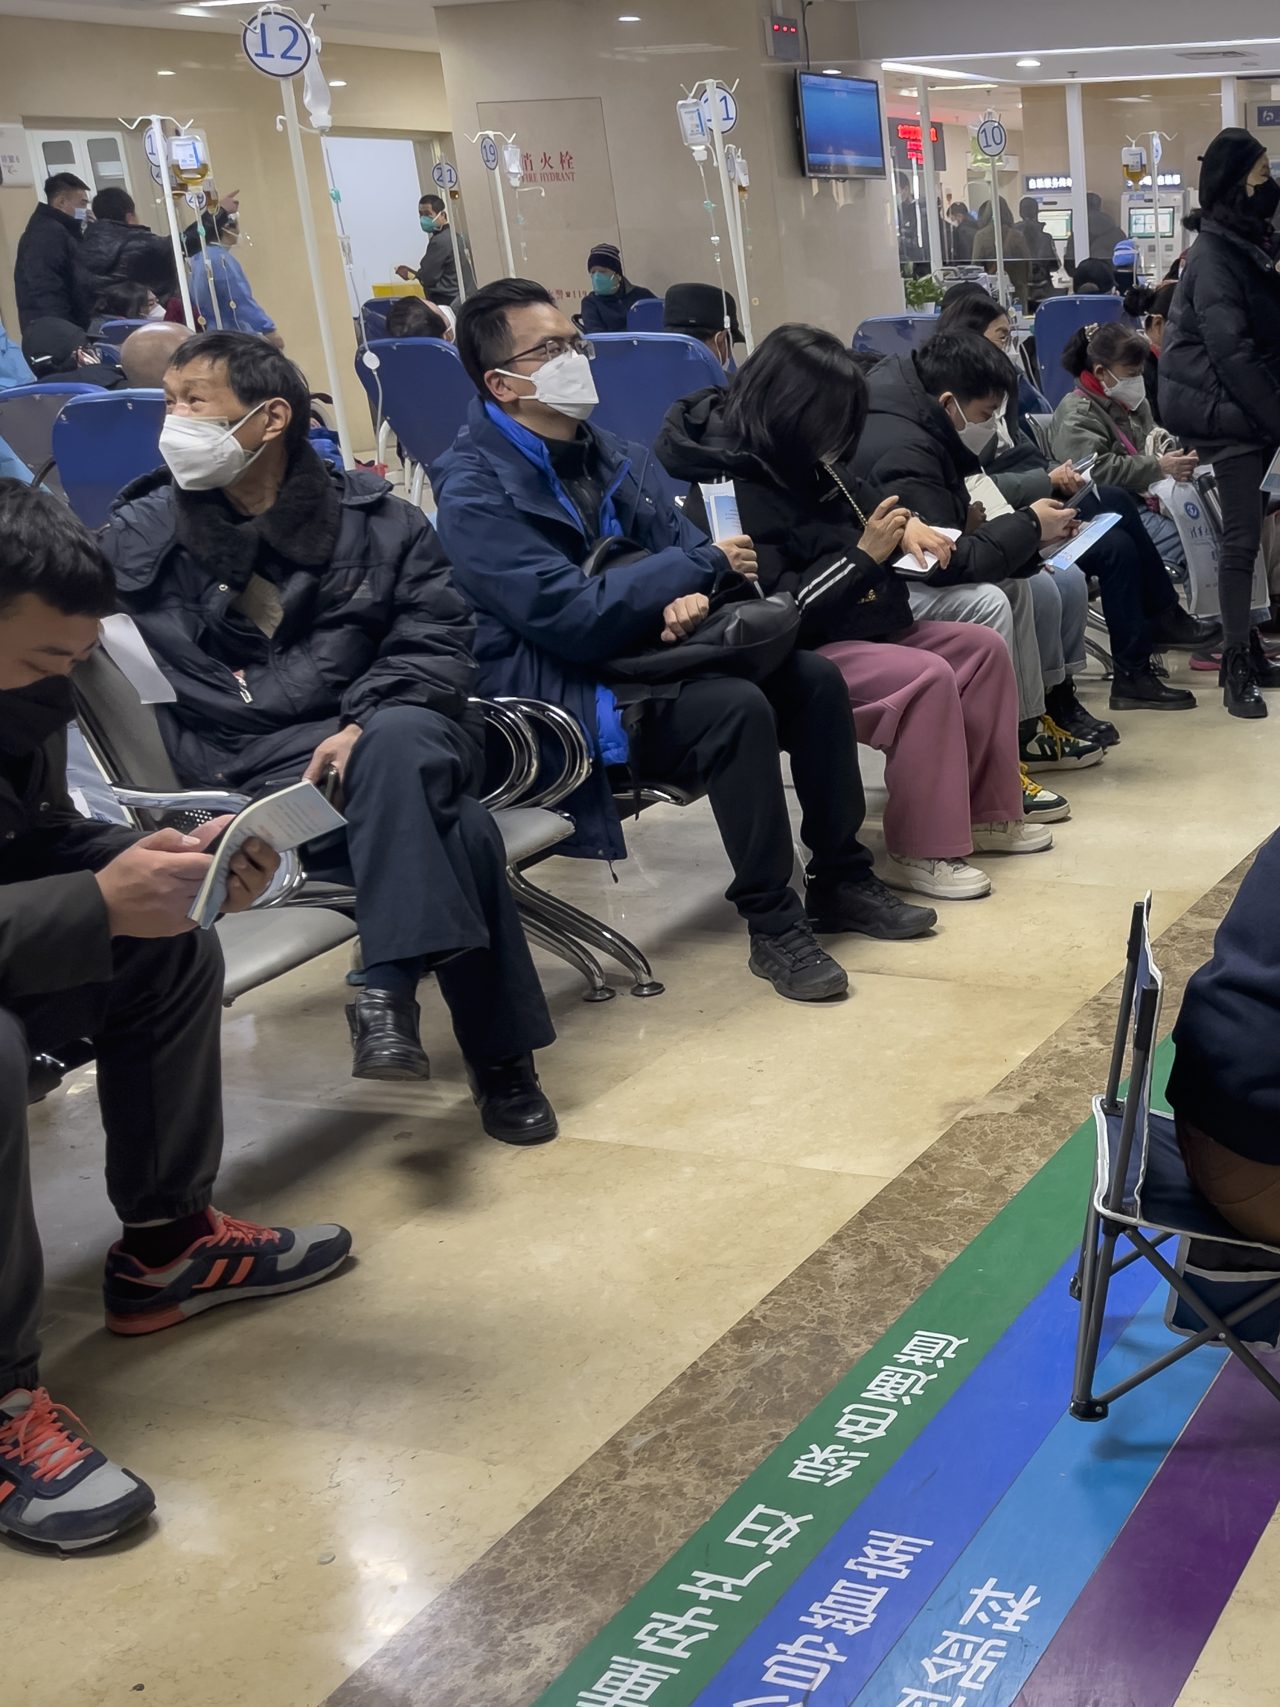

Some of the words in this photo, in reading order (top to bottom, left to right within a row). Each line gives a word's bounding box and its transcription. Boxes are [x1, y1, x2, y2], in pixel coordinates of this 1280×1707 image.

[254, 22, 302, 61] 12
[981, 125, 1003, 148] 10
[483, 144, 496, 162] 19
[436, 167, 454, 183] 21
[540, 171, 575, 182] HYDRANT
[788, 1330, 969, 1487] 绿色通道
